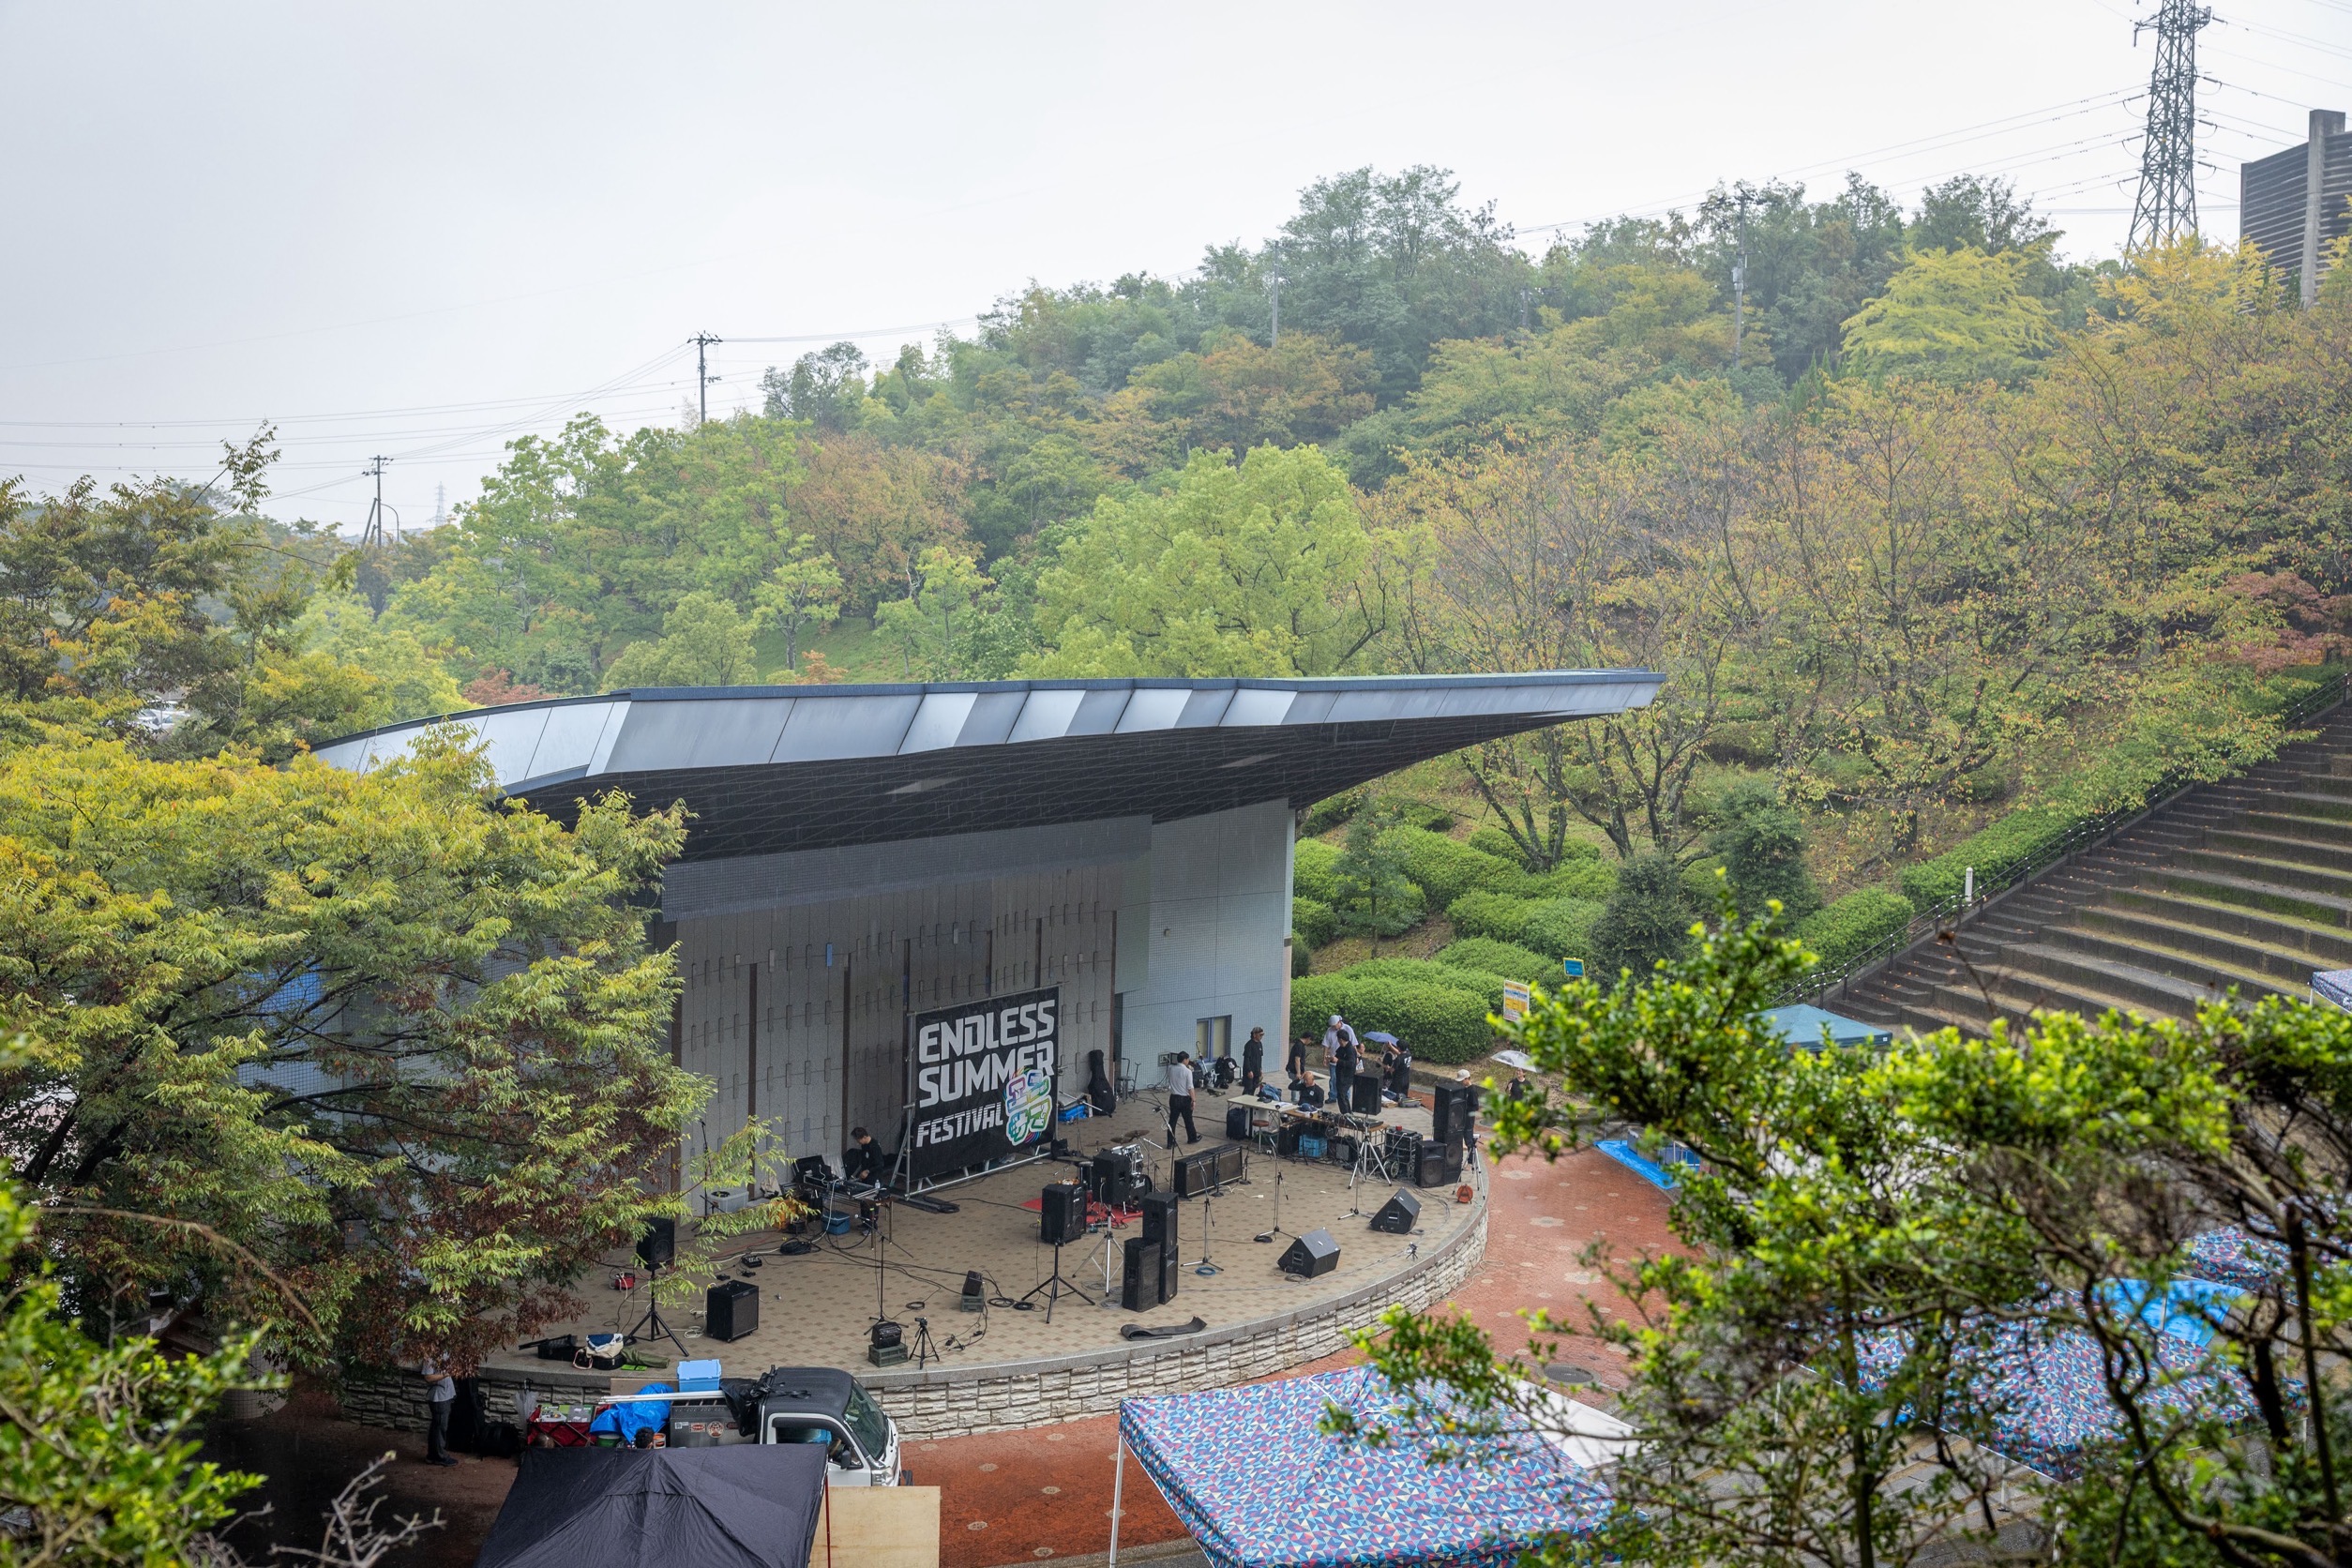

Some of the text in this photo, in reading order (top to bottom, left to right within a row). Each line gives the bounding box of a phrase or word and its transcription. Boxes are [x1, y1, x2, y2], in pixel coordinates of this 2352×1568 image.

[919, 1000, 1055, 1063] ENDLESS
[919, 1040, 1054, 1108] SUMMER
[916, 1102, 1003, 1147] FESTIVAL
